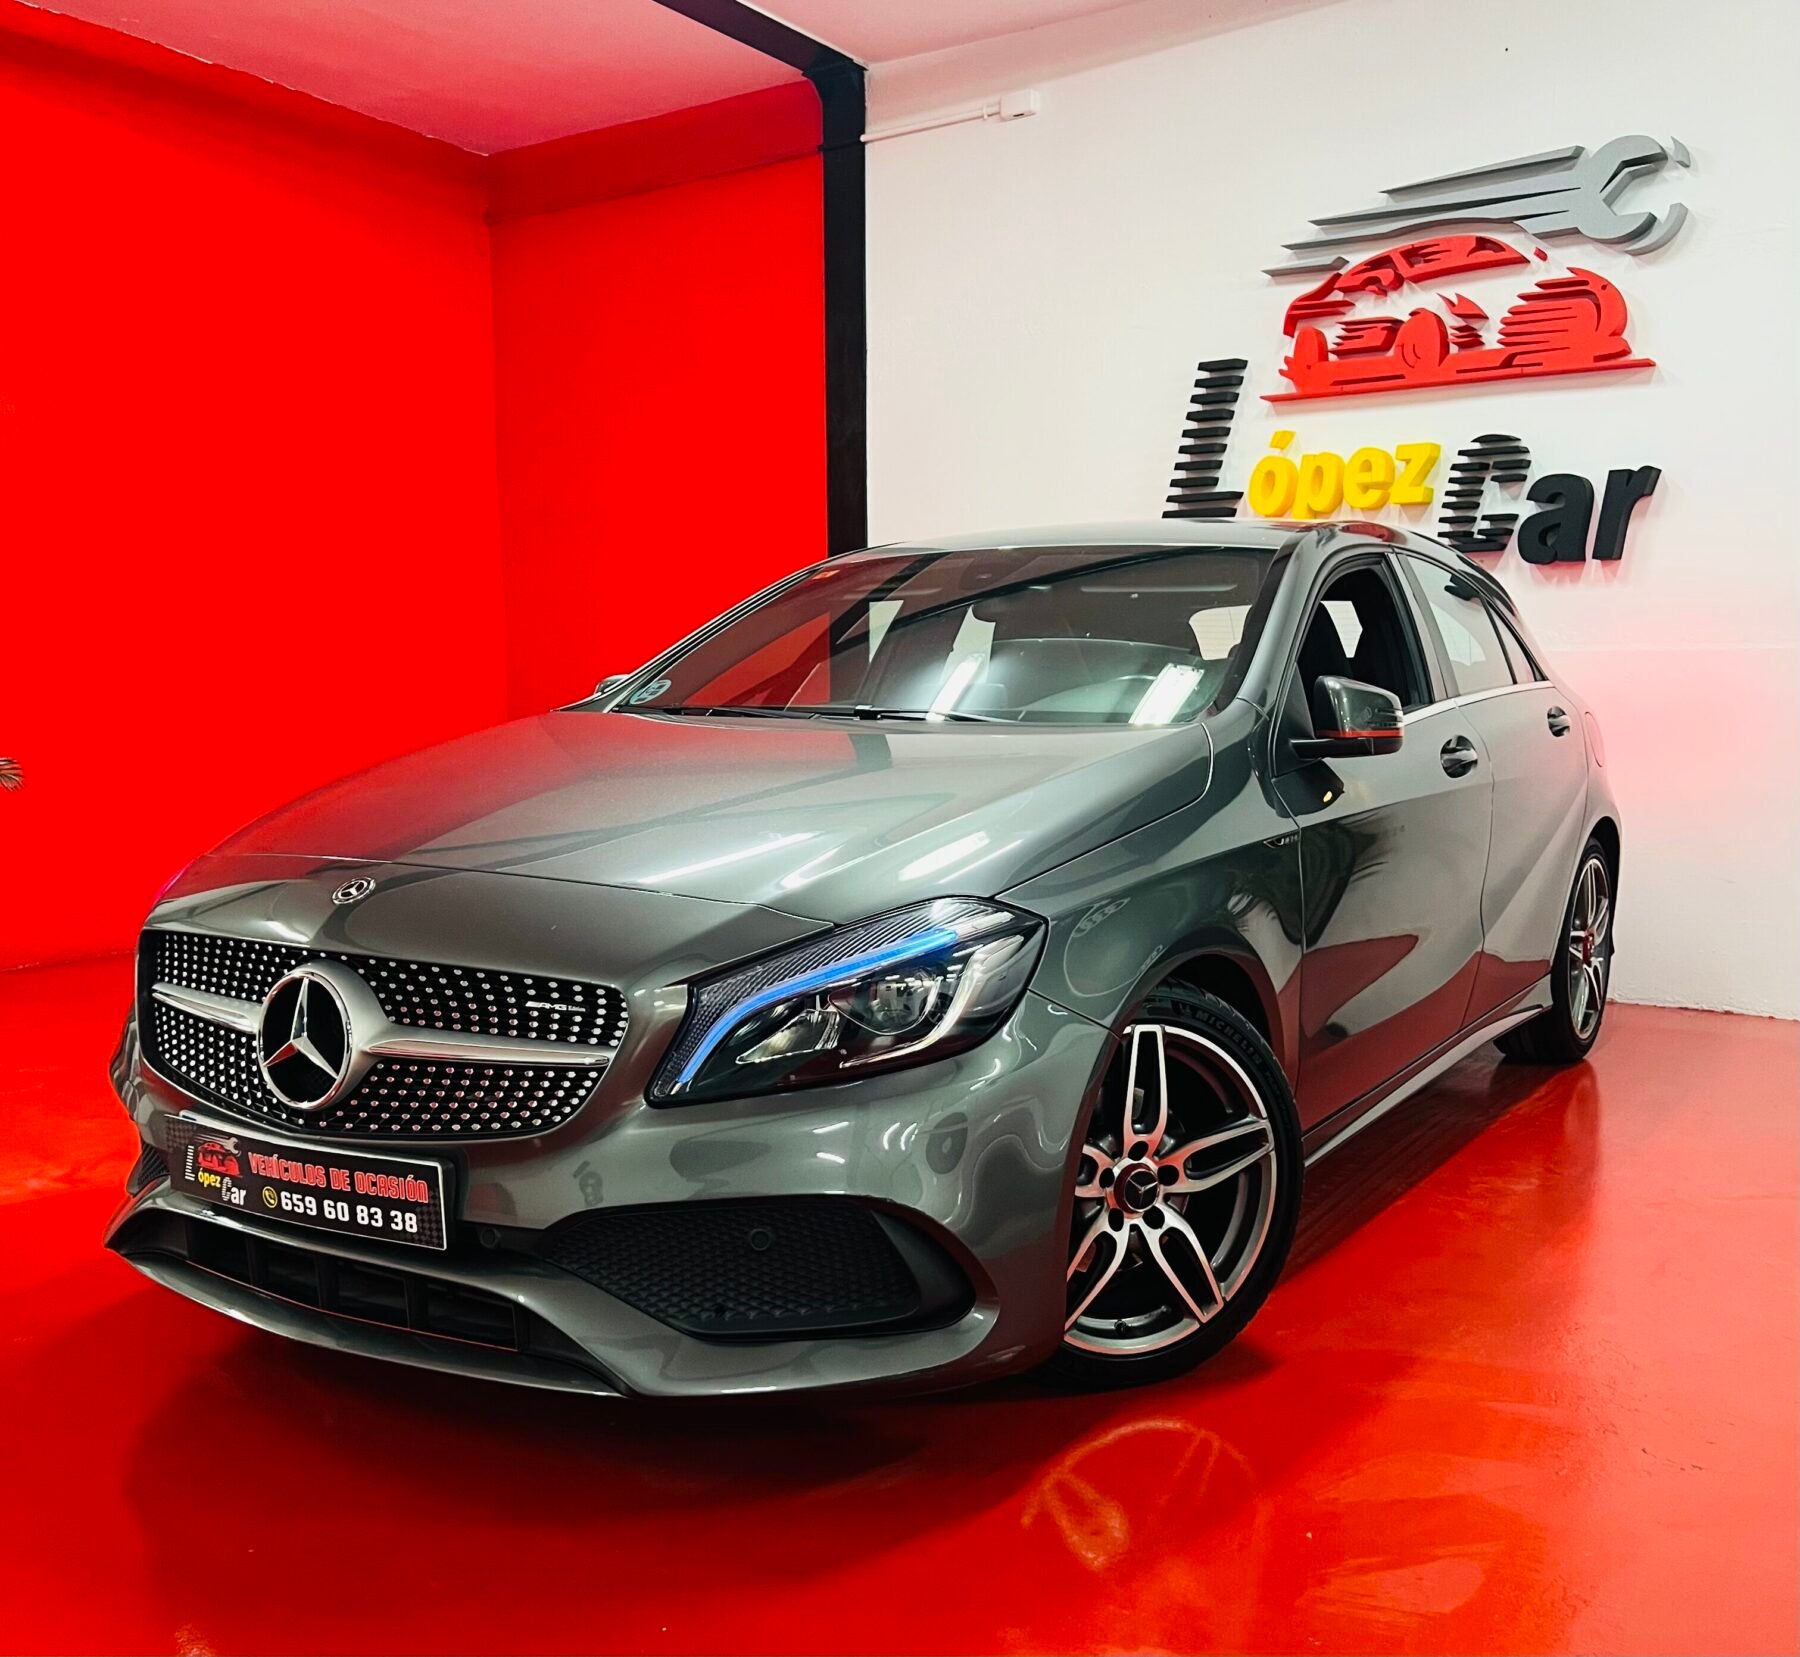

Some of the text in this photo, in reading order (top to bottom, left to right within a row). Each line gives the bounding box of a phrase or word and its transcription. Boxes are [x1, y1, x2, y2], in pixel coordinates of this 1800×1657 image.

[1162, 358, 1662, 564] López Car
[185, 1145, 246, 1206] López Car
[248, 1151, 429, 1204] VEHÍCULOS DE OCASIÓN
[280, 1191, 418, 1233] 659 60 83 38
